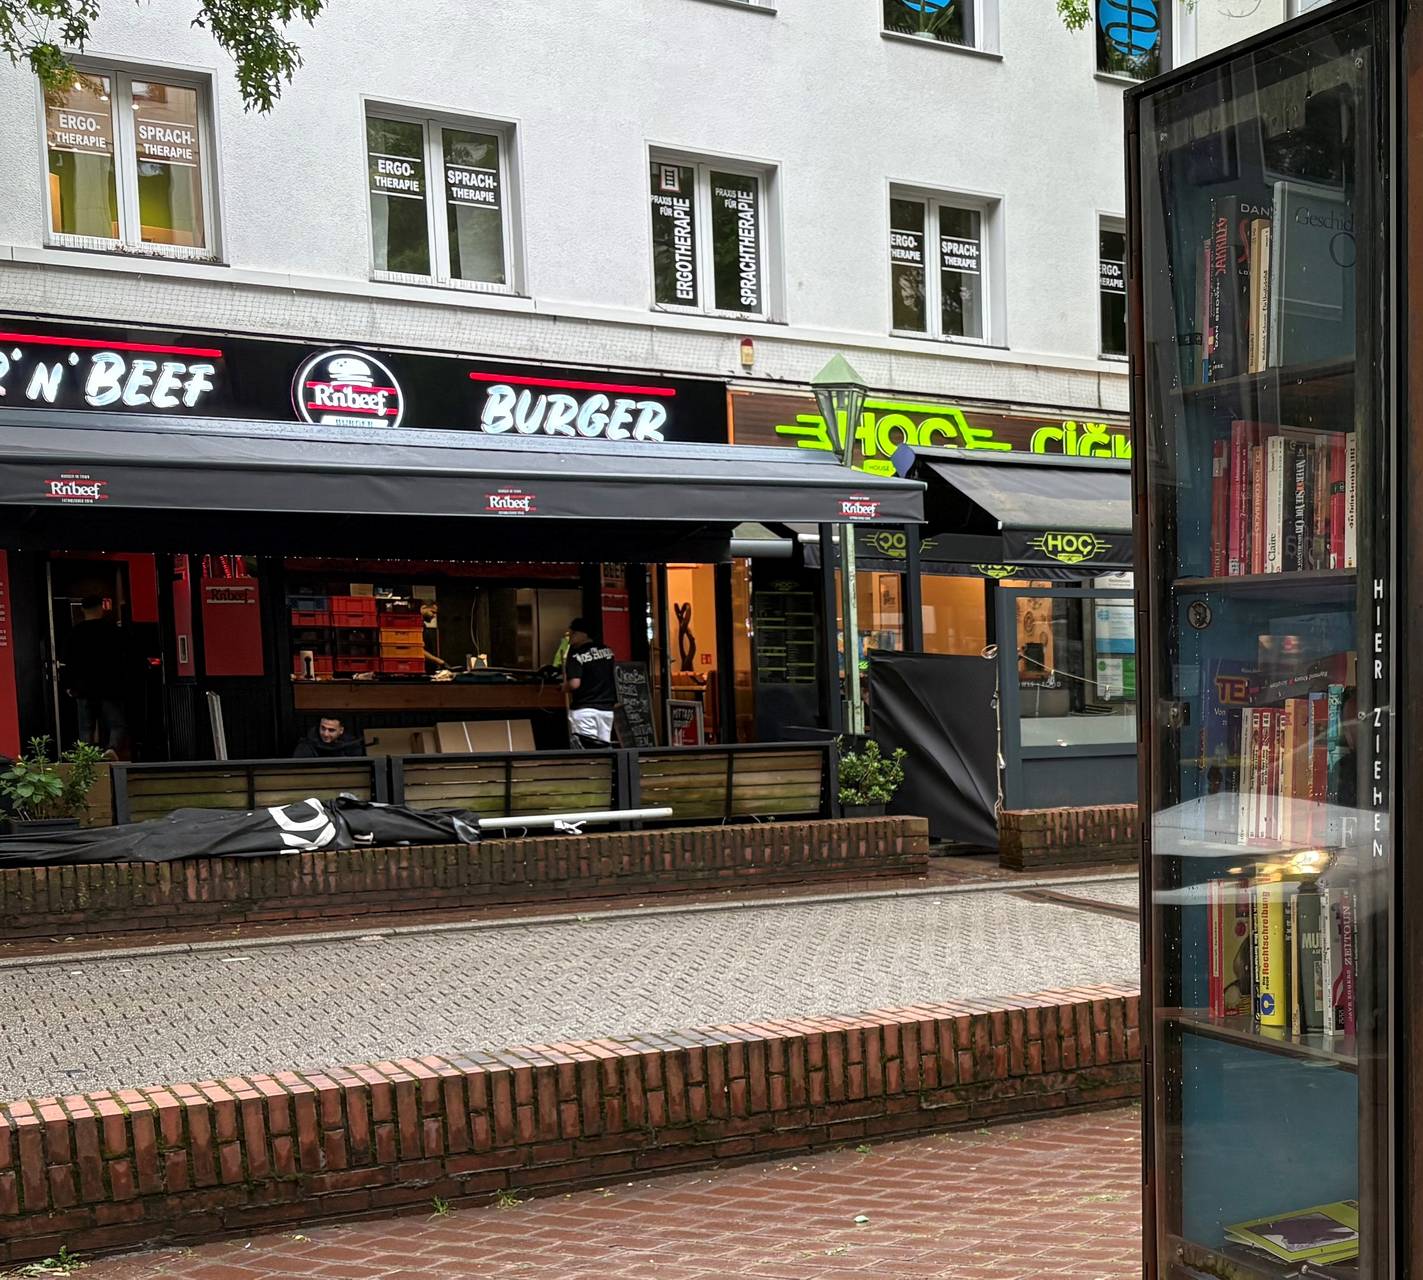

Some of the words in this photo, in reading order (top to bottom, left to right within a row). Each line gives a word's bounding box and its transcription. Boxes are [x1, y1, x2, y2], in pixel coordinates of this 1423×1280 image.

[60, 114, 100, 133] ERGO-
[55, 130, 106, 150] THERAPIE
[139, 125, 195, 144] SPRACH-
[143, 142, 192, 160] THERAPIE
[378, 160, 414, 177] ERGO-
[447, 169, 497, 187] SPRACH-
[375, 174, 419, 193] THERAPIE
[716, 188, 736, 198] PRAXIS
[452, 187, 495, 203] THERAPIE
[651, 195, 672, 206] PRAXIS
[725, 199, 736, 208] FÜR
[660, 206, 672, 216] FÜR
[673, 198, 693, 299] ERGOTHERAPIE
[738, 191, 757, 306] SPRACHTHERAPIE
[891, 234, 917, 248] ERGO-
[942, 241, 979, 256] SPRACH-
[944, 256, 976, 268] THERAPIE
[84, 351, 216, 408] BEEF
[480, 384, 668, 443] BURGER
[1047, 535, 1092, 555] HOÇ
[1268, 533, 1276, 562] Claire
[1373, 579, 1384, 680] HIER
[1373, 708, 1383, 858] ZIEHEN
[1262, 891, 1271, 976] Rechtschreibung
[1343, 904, 1353, 966] ZEITOUN
